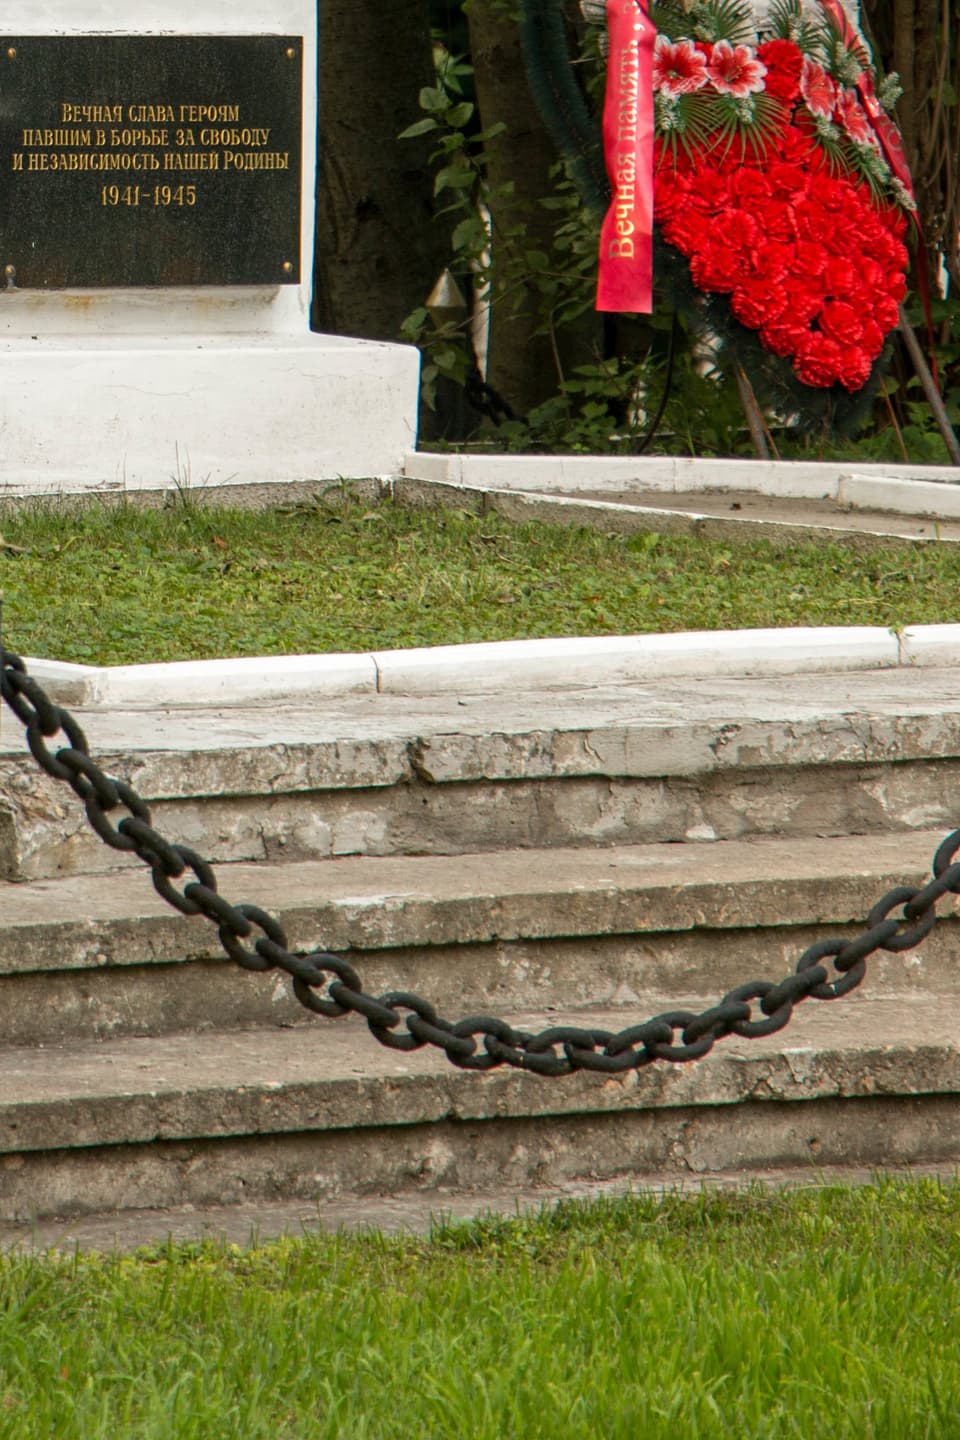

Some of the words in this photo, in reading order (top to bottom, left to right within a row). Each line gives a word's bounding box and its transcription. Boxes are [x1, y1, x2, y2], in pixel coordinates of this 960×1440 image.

[61, 104, 123, 123] ВЕЧНАЯ
[128, 105, 175, 123] СЛАВА
[180, 105, 239, 122] ГЕРОЯМ
[23, 129, 91, 147] ПАВШИМ
[95, 130, 106, 147] В
[110, 129, 169, 147] БОРЬБЕ
[175, 129, 196, 146] ЗА
[200, 129, 270, 147] СВОБОДУ
[13, 154, 23, 171] И
[27, 153, 159, 171] НЕЗАВИСИМОСТЬ
[164, 151, 219, 171] НАШЕЙ
[222, 151, 289, 171] РОДИНЫ
[101, 186, 196, 206] 1941-1945
[608, 150, 636, 260] Вечная
